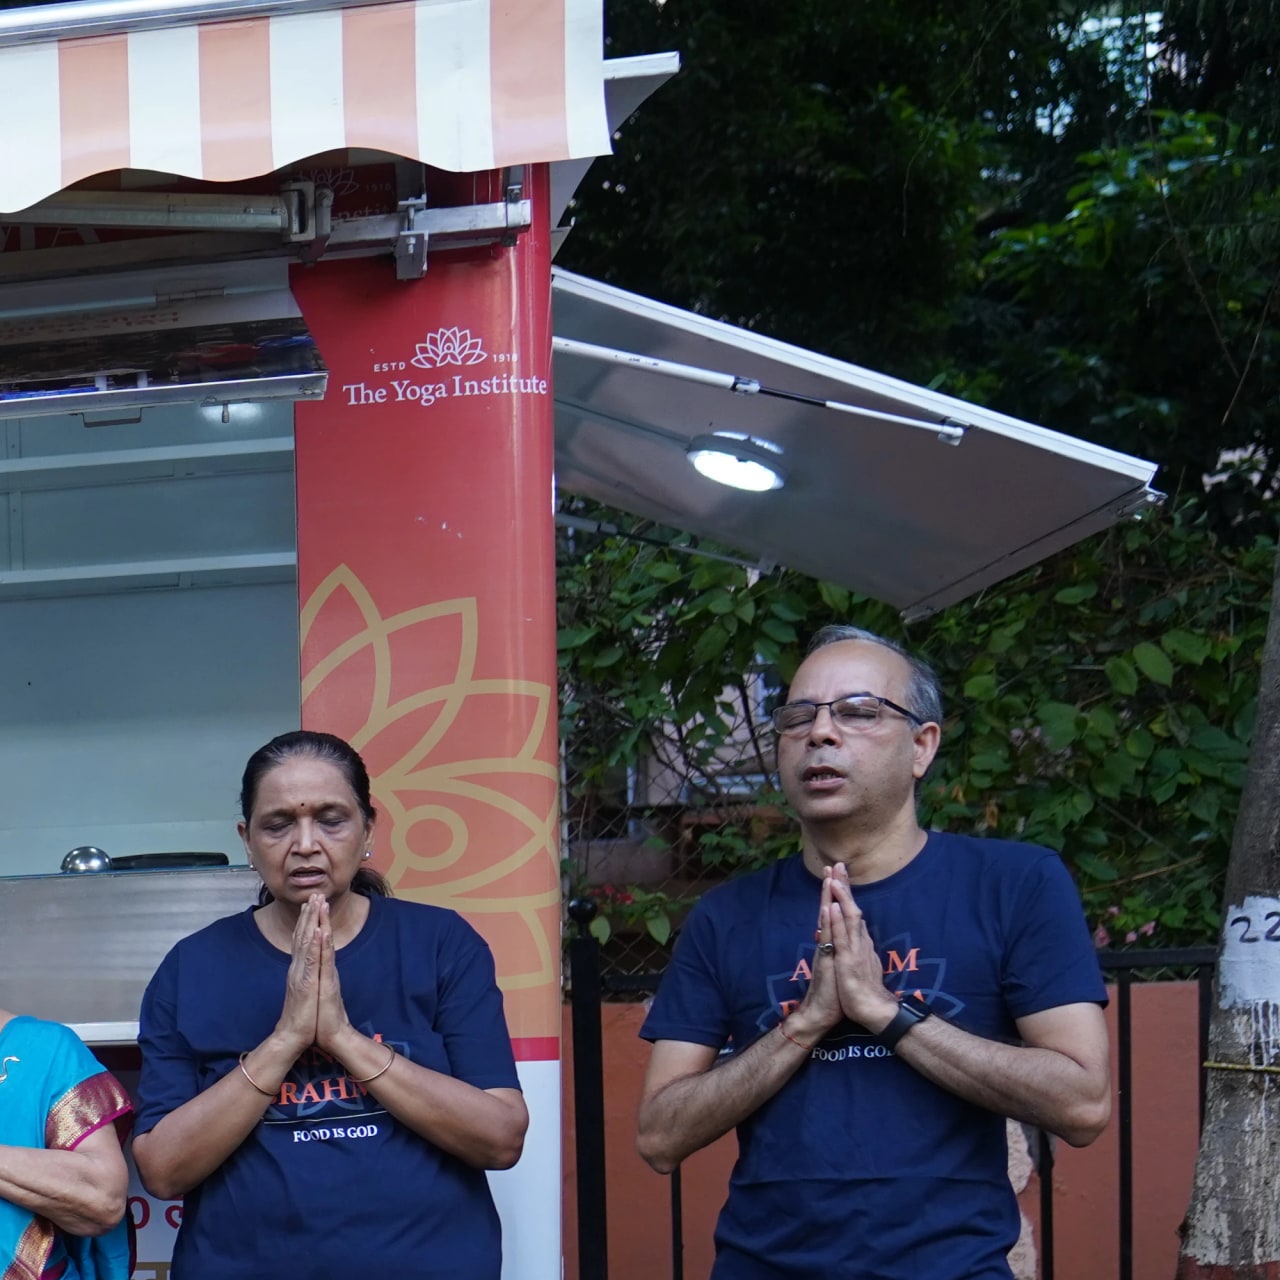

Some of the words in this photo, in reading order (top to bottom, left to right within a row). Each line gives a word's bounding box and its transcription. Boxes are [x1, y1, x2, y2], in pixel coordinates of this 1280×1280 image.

[373, 361, 406, 373] ESTD
[342, 383, 388, 406] The
[390, 379, 449, 406] Yoga
[452, 374, 548, 396] Institute
[847, 1045, 861, 1058] IS
[293, 1129, 331, 1143] FOOD
[333, 1127, 345, 1139] IS
[346, 1124, 378, 1138] GOD
